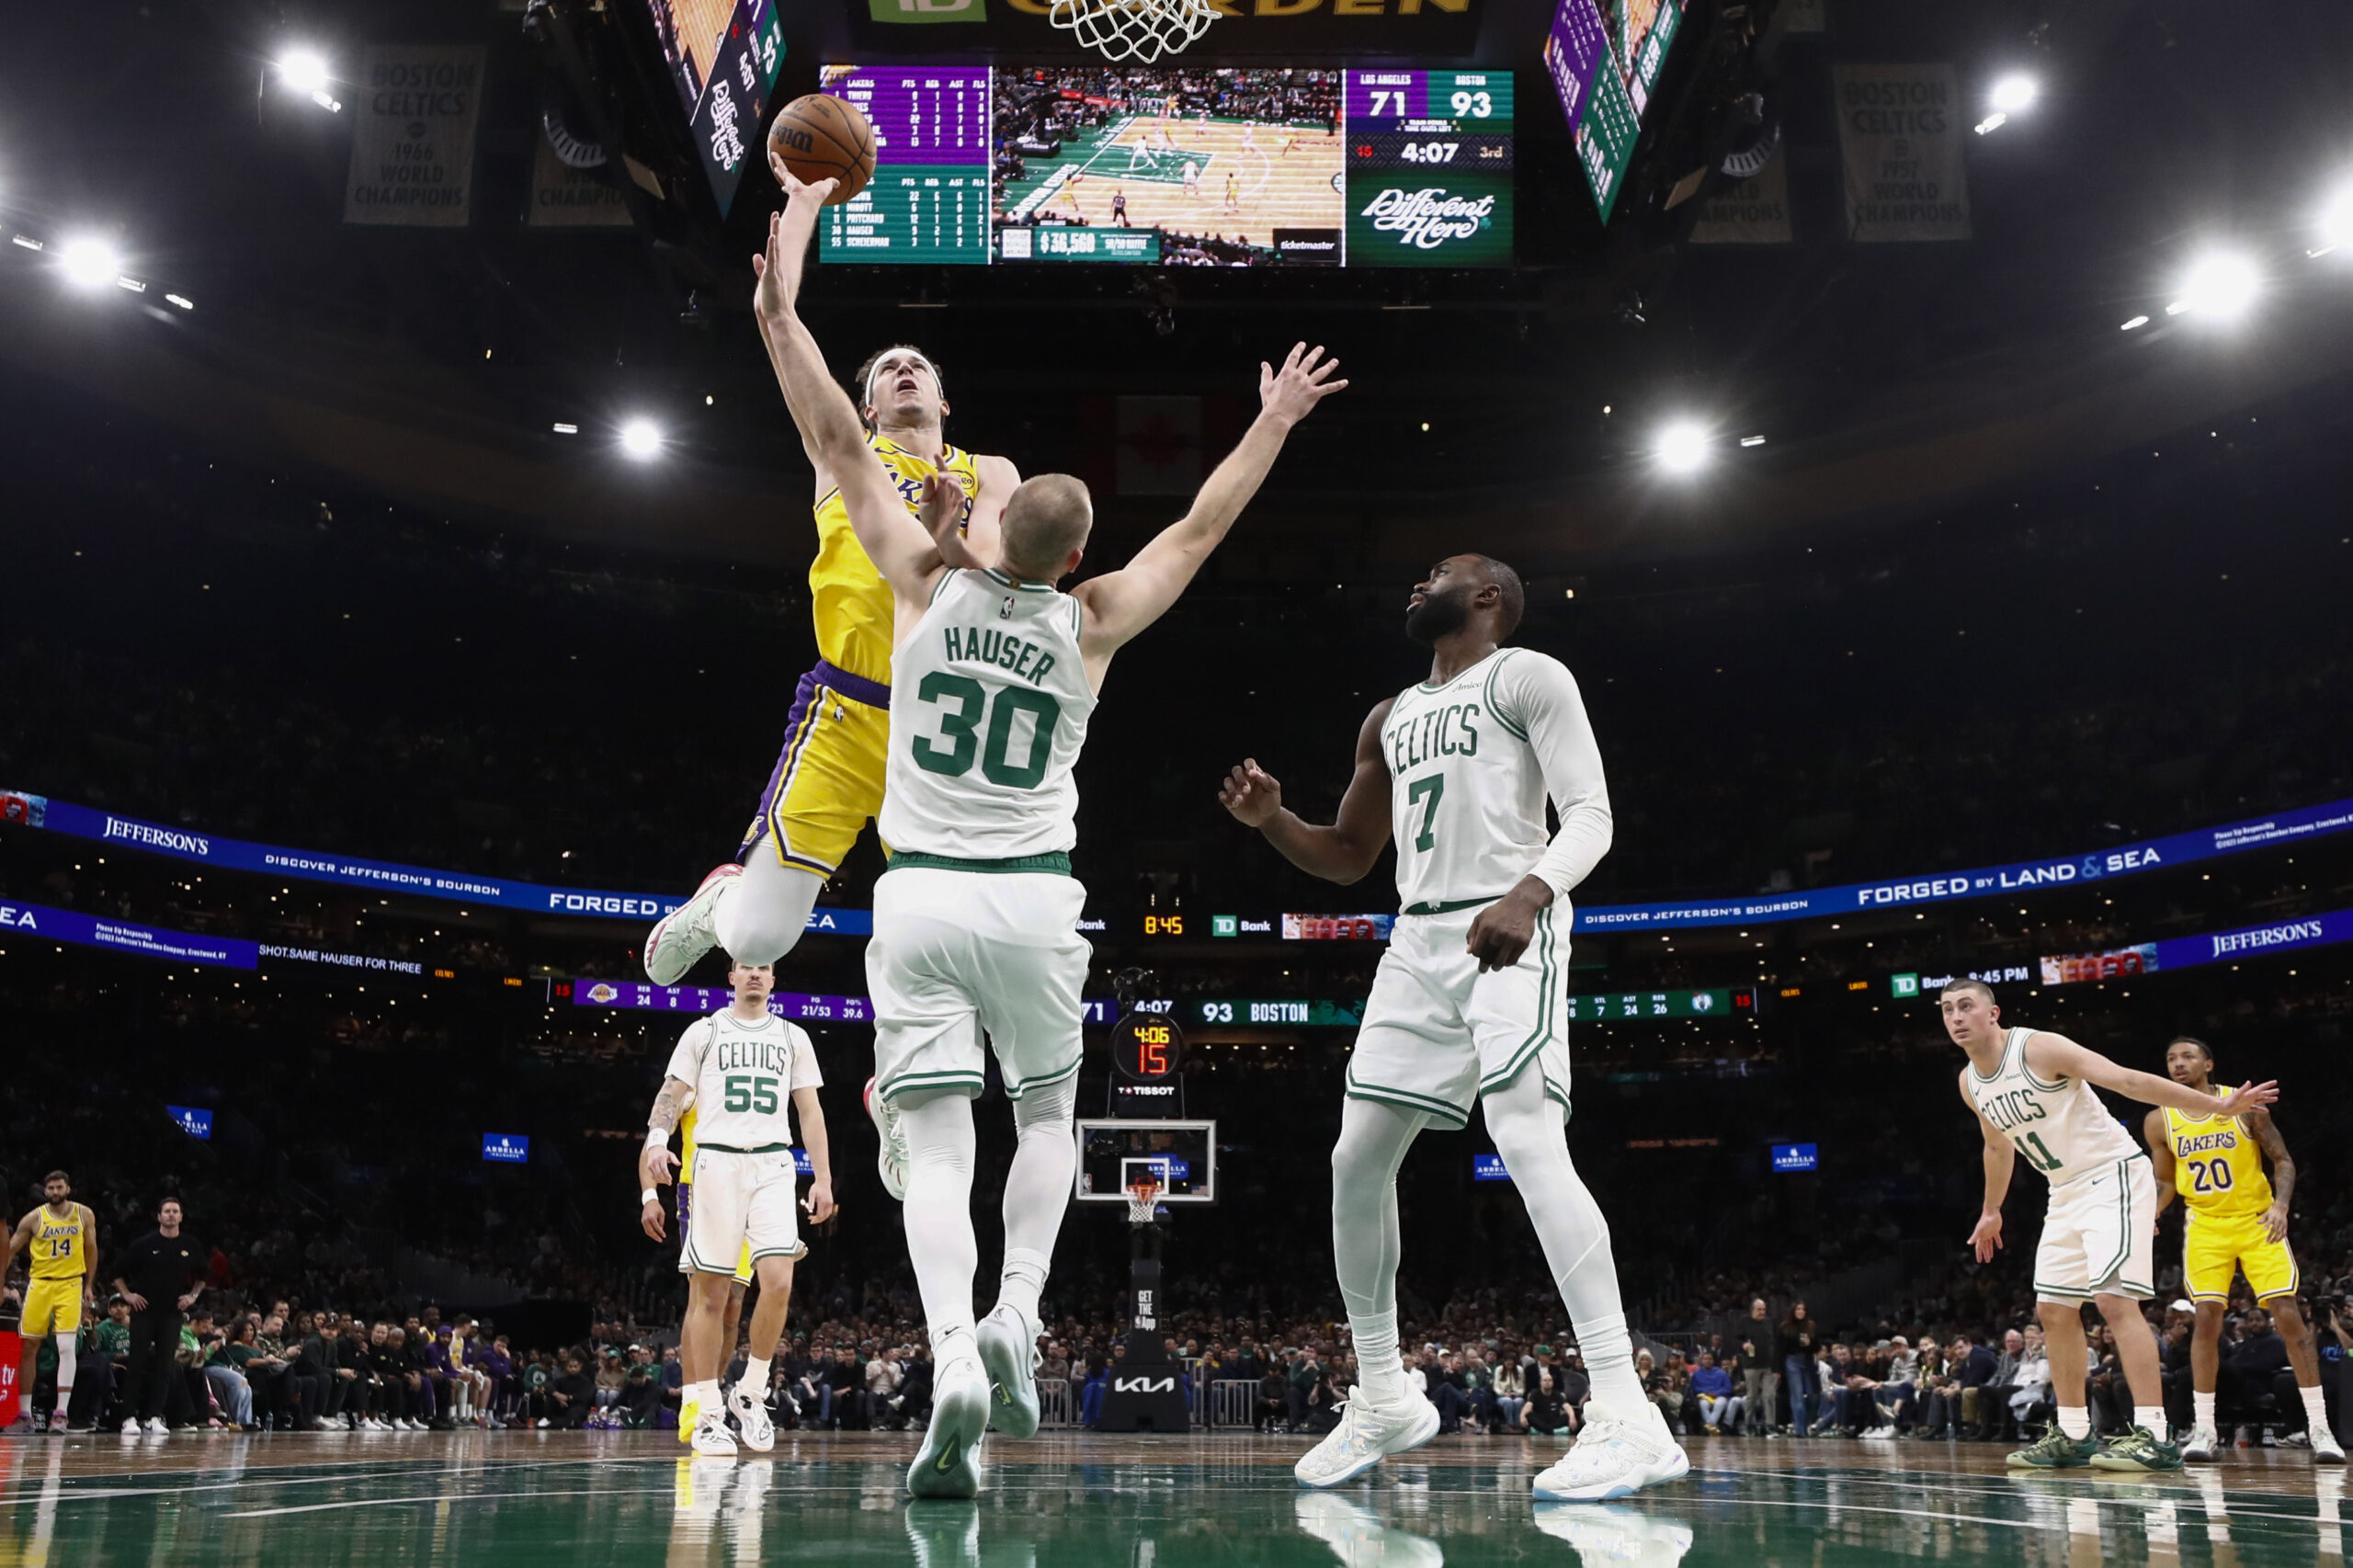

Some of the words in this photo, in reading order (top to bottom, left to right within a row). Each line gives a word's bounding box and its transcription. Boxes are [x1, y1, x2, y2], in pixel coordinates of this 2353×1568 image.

[371, 63, 473, 86] BOSTON
[1360, 74, 1376, 85] LOS
[372, 92, 466, 116] CELTICS
[1370, 91, 1406, 117] 71
[1450, 91, 1493, 118] 93
[1846, 81, 1948, 106] BOSTON
[1851, 108, 1947, 134] CELTICS
[394, 143, 434, 159] 1966
[1357, 145, 1373, 158] 15
[1401, 142, 1460, 164] 4:07
[1479, 146, 1504, 159] 3rd
[380, 165, 443, 183] WORLD
[355, 187, 462, 206] CHAMPIONS
[1873, 182, 1939, 200] WORLD
[1361, 188, 1495, 222] Different
[1855, 203, 1962, 222] CHAMPIONS
[1373, 214, 1479, 249] Here
[1279, 240, 1335, 251] ticketmaster
[944, 626, 1056, 686] HAUSER
[1452, 680, 1483, 693] Amica
[912, 670, 1061, 790] 30
[1385, 703, 1481, 779] CELTICS
[1408, 773, 1444, 854] 7
[103, 816, 209, 856] JEFFERSON'S
[265, 855, 336, 873] DISCOVER
[339, 865, 432, 887] JEFFERSON'S
[436, 879, 501, 897] BOURBON
[1858, 877, 1970, 905] FORGED
[1975, 877, 1995, 889] BY
[2000, 863, 2077, 889] LAND
[2081, 856, 2102, 879] &
[2107, 846, 2161, 872] SEA
[0, 905, 38, 930] EA
[549, 892, 658, 916] FORGED
[805, 913, 836, 930] EA
[1585, 912, 1650, 925] DISCOVER
[1653, 906, 1742, 921] JEFFERSON'S
[1745, 900, 1809, 915] BOURBON
[1075, 919, 1106, 931] Bank
[1145, 915, 1183, 935] 8:45
[1215, 918, 1235, 933] TD
[1241, 920, 1271, 932] Bank
[2212, 920, 2323, 958] JEFFERSON'S
[321, 951, 363, 968] HAUSER
[365, 957, 387, 971] FOR
[389, 960, 423, 975] THREE
[2005, 966, 2029, 983] PM
[1894, 976, 1916, 994] TD
[1922, 974, 1955, 990] Bank
[637, 994, 651, 1006] 24
[669, 996, 677, 1007] 8
[700, 998, 708, 1009] 5
[801, 1005, 831, 1017] 21/53
[843, 1007, 864, 1019] 39.6
[1134, 1000, 1174, 1014] 4:07
[1202, 1003, 1233, 1022] 93
[1250, 1003, 1309, 1023] BOSTON
[1568, 1007, 1576, 1017] 8
[1597, 1006, 1605, 1017] 7
[1624, 1005, 1638, 1016] 24
[1654, 1004, 1667, 1015] 26
[1134, 1027, 1170, 1044] 4:06
[718, 1041, 787, 1076] CELTICS
[1139, 1044, 1167, 1074] 15
[724, 1074, 779, 1116] 55
[1133, 1086, 1175, 1096] TISSOT
[2014, 1131, 2063, 1172] 11
[2176, 1131, 2237, 1158] LAKERS
[2188, 1157, 2234, 1193] 20
[42, 1224, 79, 1239] LAKERS
[51, 1238, 72, 1258] 14
[1138, 1290, 1153, 1303] GET
[1139, 1303, 1153, 1315] THE
[1142, 1316, 1156, 1330] App
